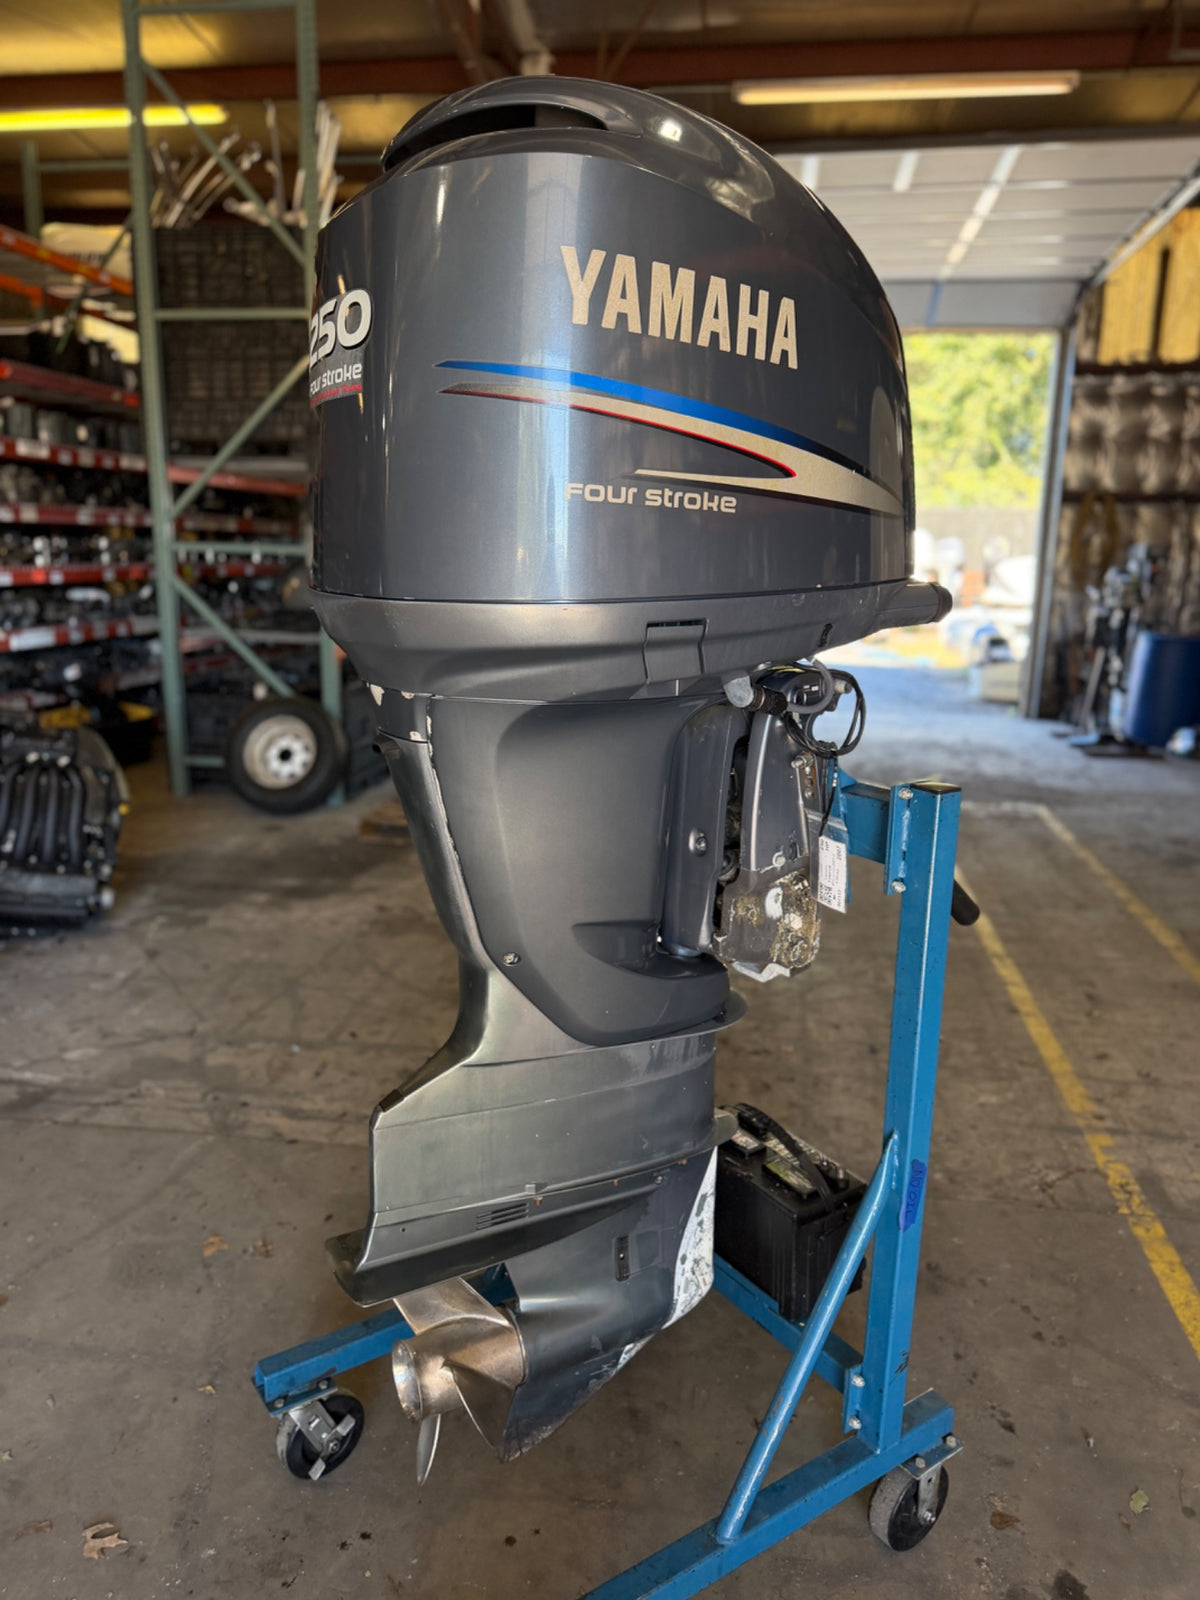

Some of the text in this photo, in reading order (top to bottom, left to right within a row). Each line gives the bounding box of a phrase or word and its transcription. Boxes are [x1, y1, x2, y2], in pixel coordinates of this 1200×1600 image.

[310, 289, 372, 369] 250
[560, 245, 798, 370] YAMAHA
[565, 483, 737, 513] Four stroke
